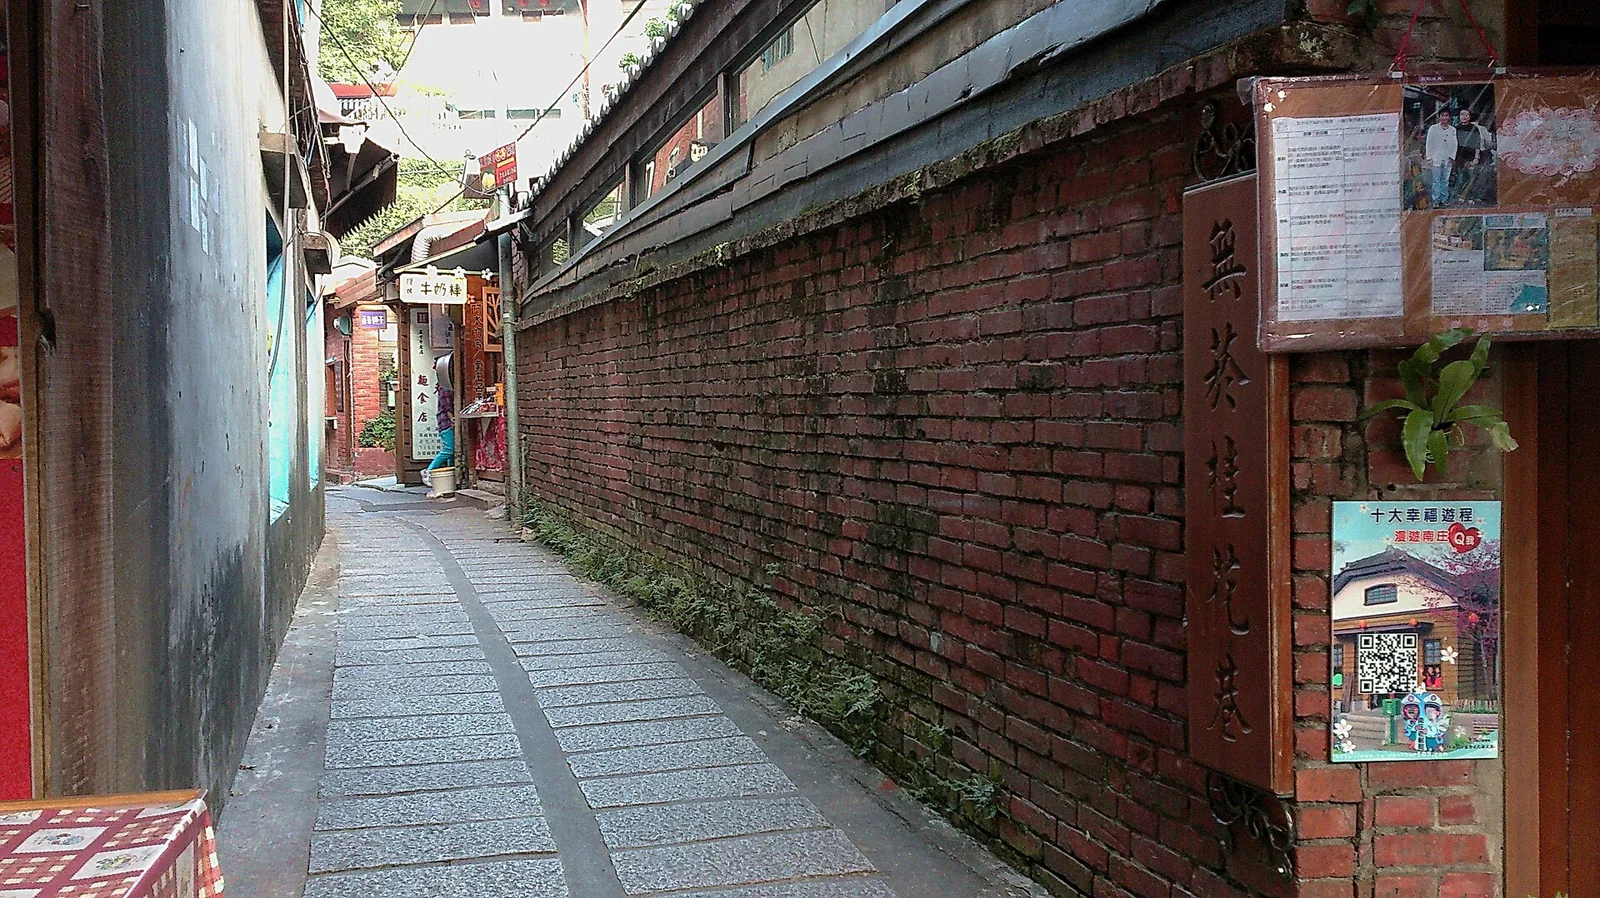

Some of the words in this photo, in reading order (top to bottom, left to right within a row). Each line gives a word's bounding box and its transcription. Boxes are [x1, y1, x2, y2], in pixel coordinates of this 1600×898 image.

[420, 281, 462, 298] 牛奶棒
[1370, 507, 1473, 523] 十大幸福遊程
[1394, 530, 1449, 543] 漫遊南庄
